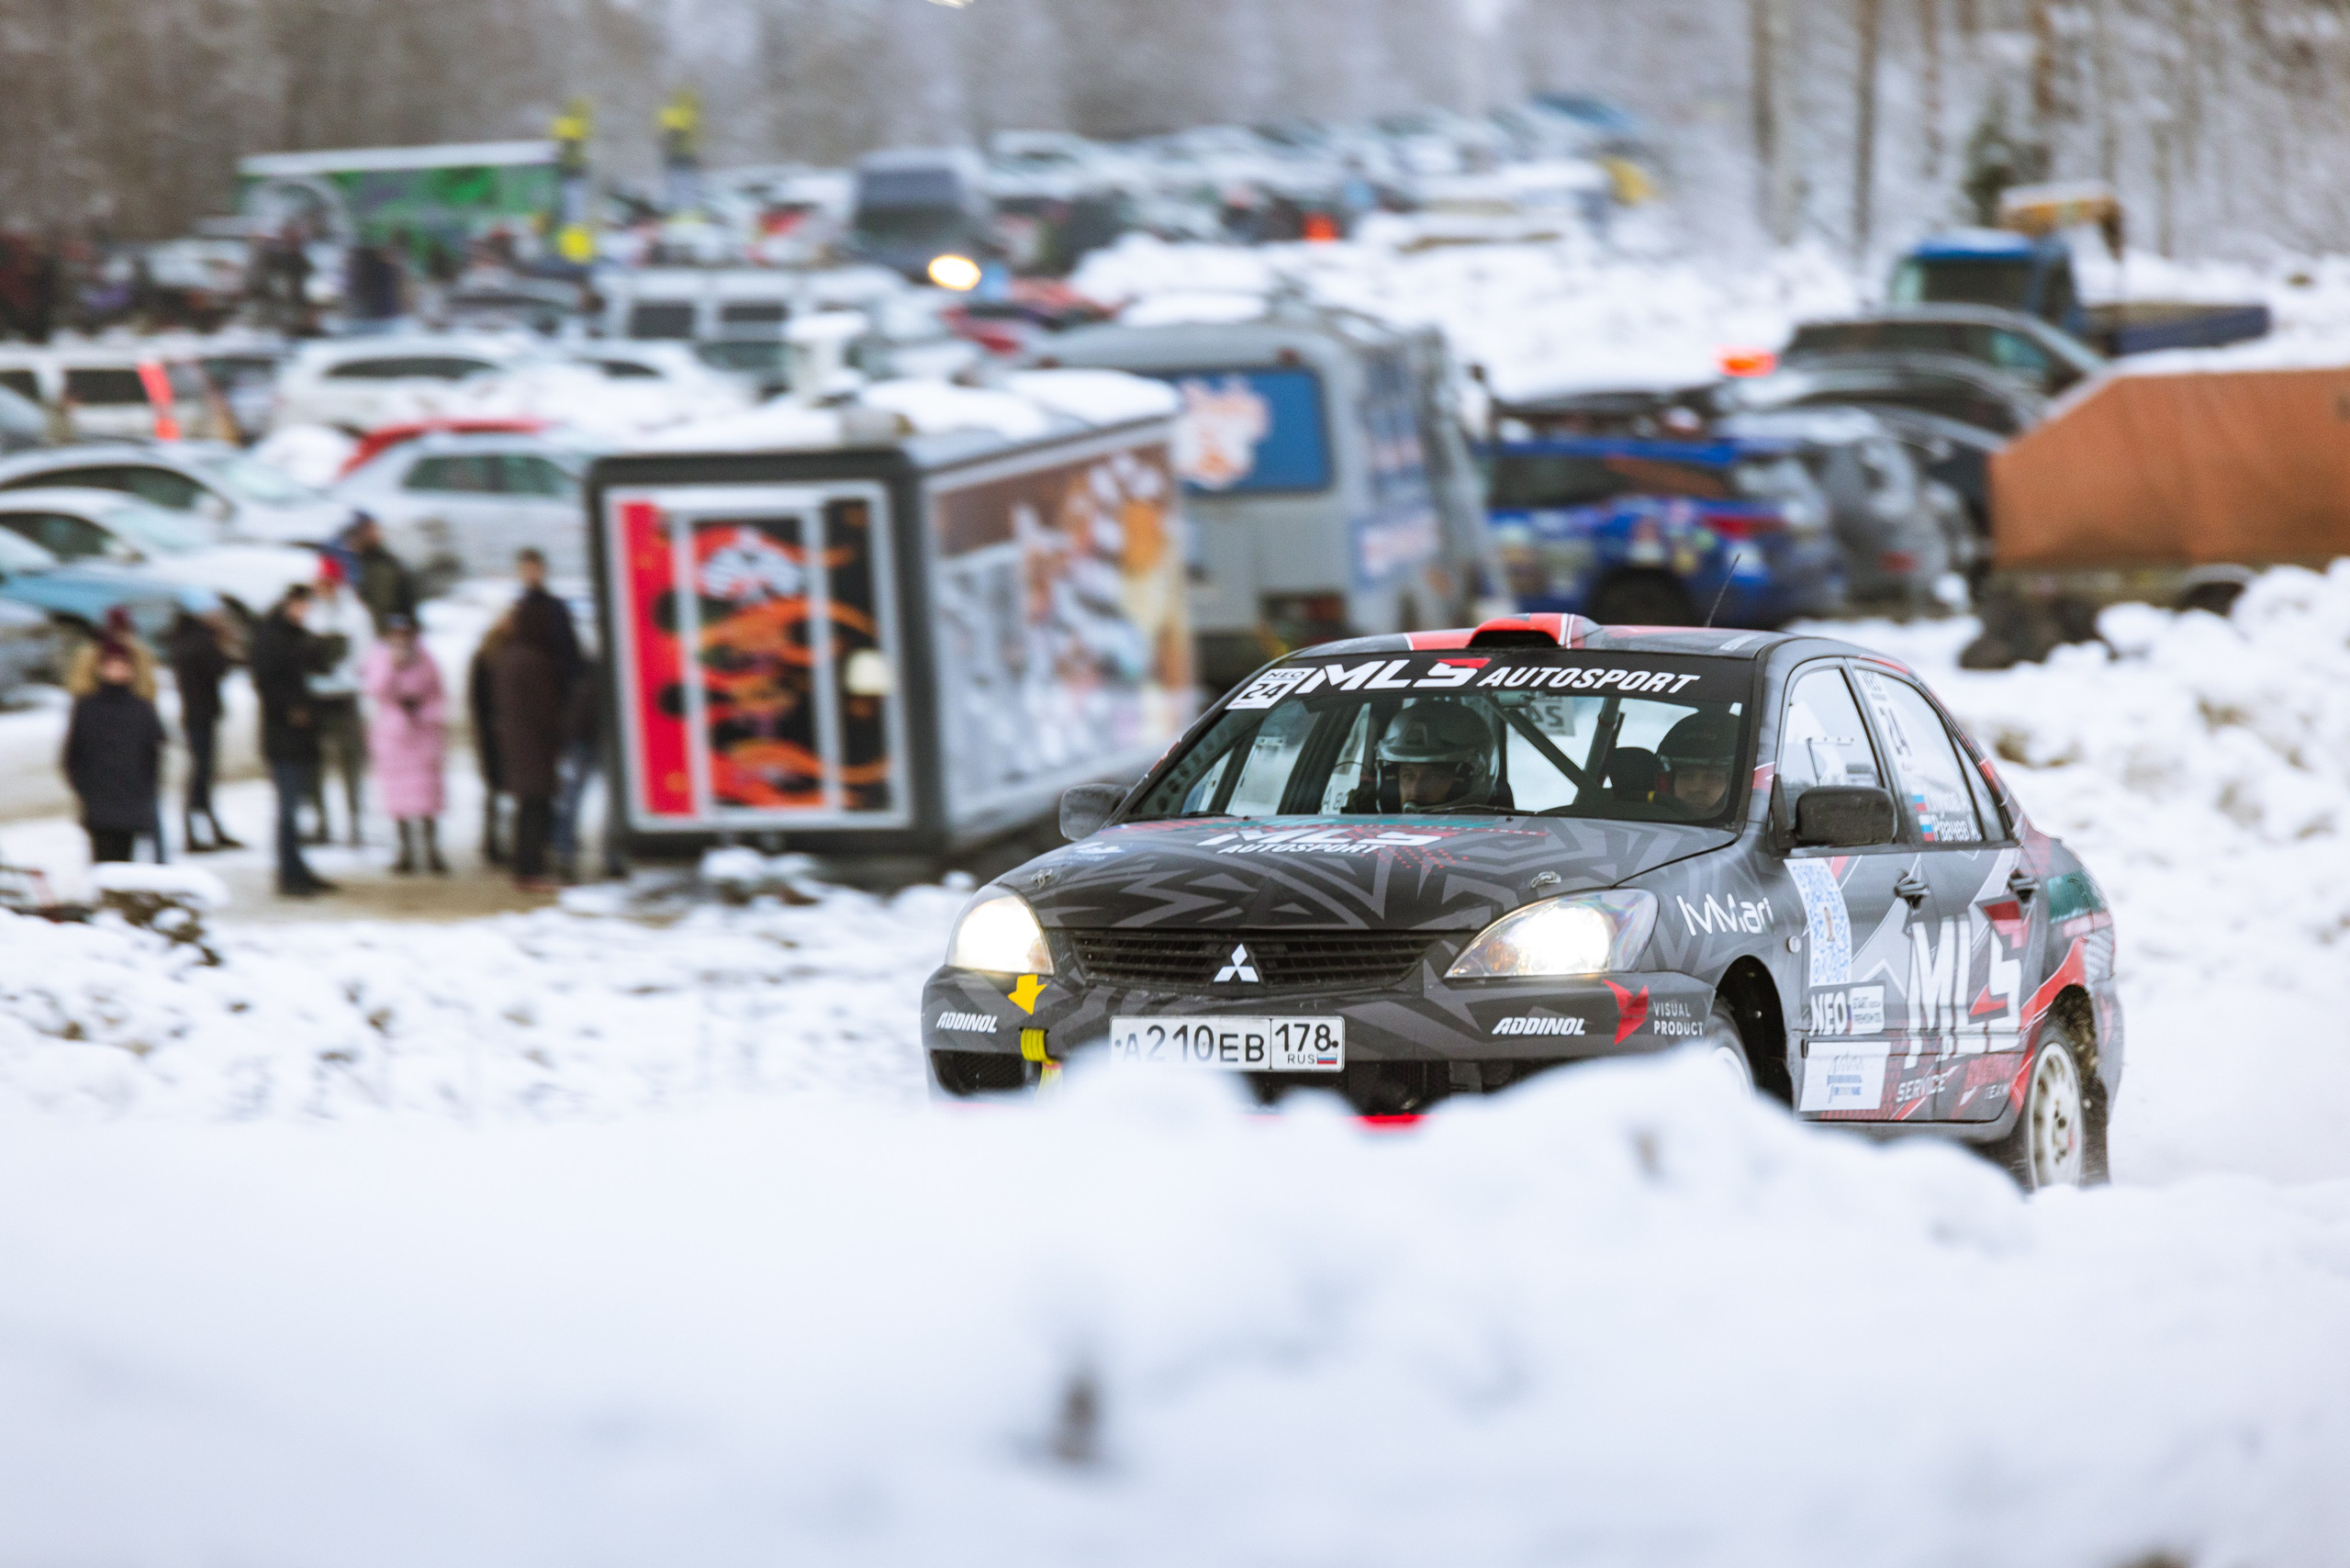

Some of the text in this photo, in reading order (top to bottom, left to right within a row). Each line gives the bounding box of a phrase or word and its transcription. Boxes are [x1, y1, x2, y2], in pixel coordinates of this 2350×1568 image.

[1266, 670, 1305, 679] NEO
[1294, 658, 1700, 694] MLS AUTOSPORT
[1240, 683, 1290, 700] 24
[1216, 843, 1385, 855] AUTOSPORT
[1904, 913, 2022, 1070] MLS
[1653, 1002, 1691, 1018] VISUAL
[1808, 991, 1848, 1036] NEO
[936, 1012, 998, 1034] ADDINOL
[1492, 1017, 1586, 1036] ADDINOL
[1653, 1022, 1704, 1036] PRODUCT
[1275, 1024, 1332, 1052] 178
[1287, 1053, 1315, 1065] RUS
